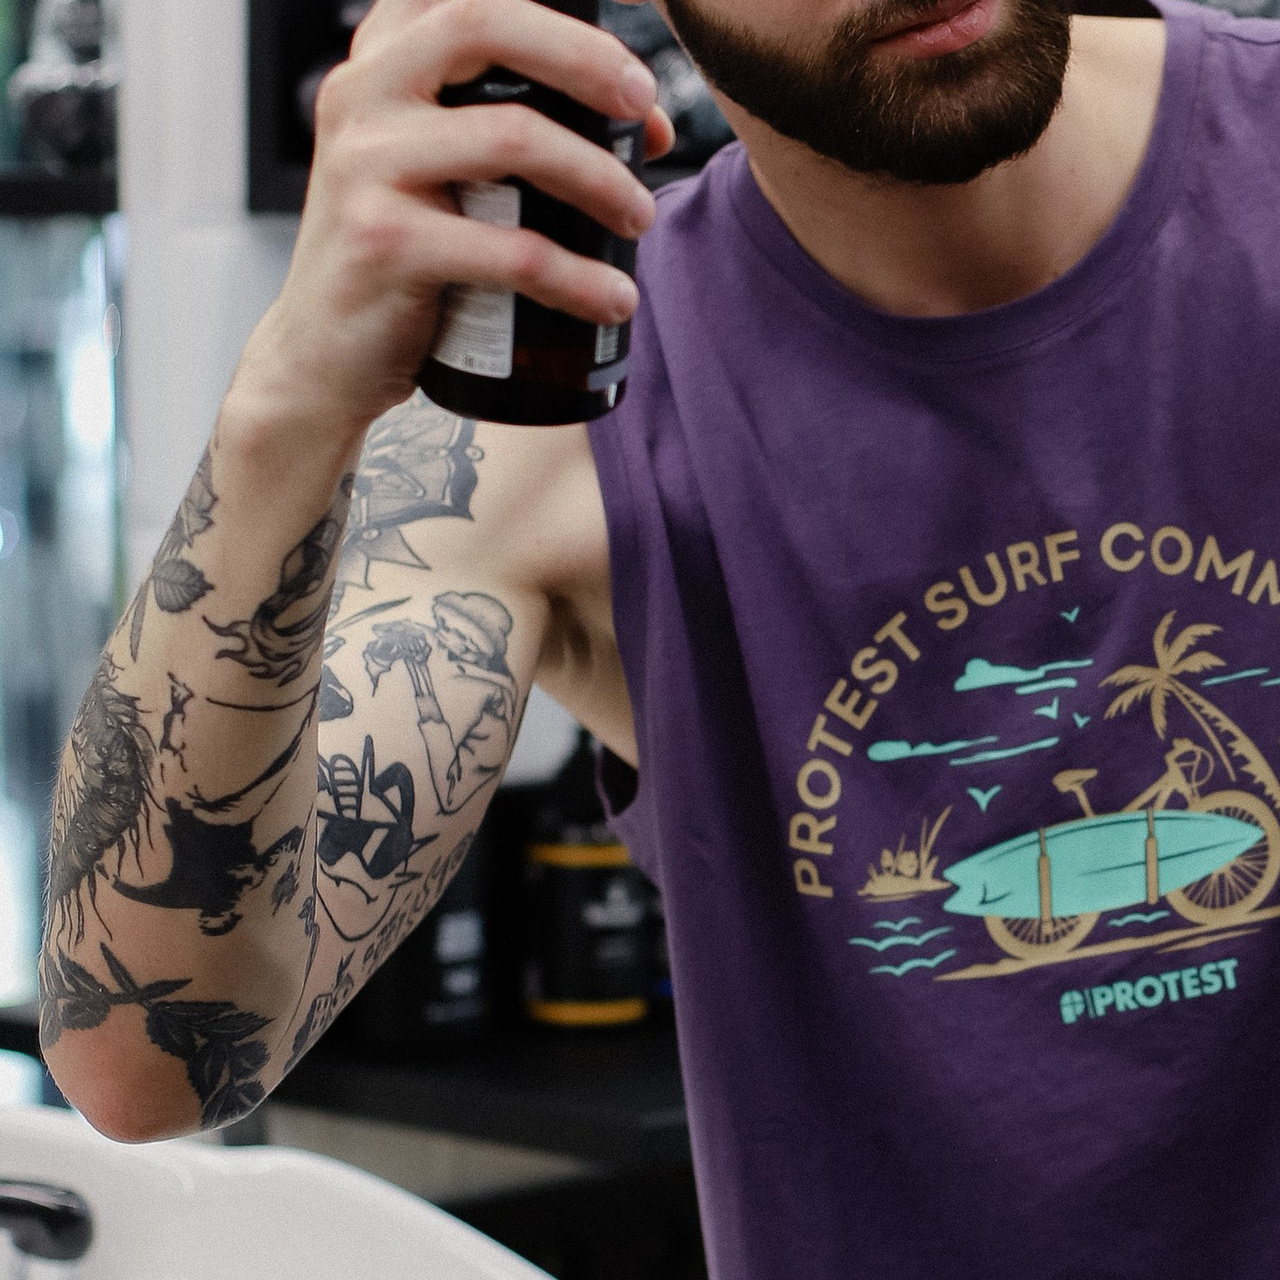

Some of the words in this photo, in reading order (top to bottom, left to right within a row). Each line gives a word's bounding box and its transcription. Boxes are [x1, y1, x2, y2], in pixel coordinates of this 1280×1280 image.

[788, 610, 922, 900] PROTEST
[923, 529, 1081, 631] SURF
[1090, 956, 1239, 1018] PROTEST
